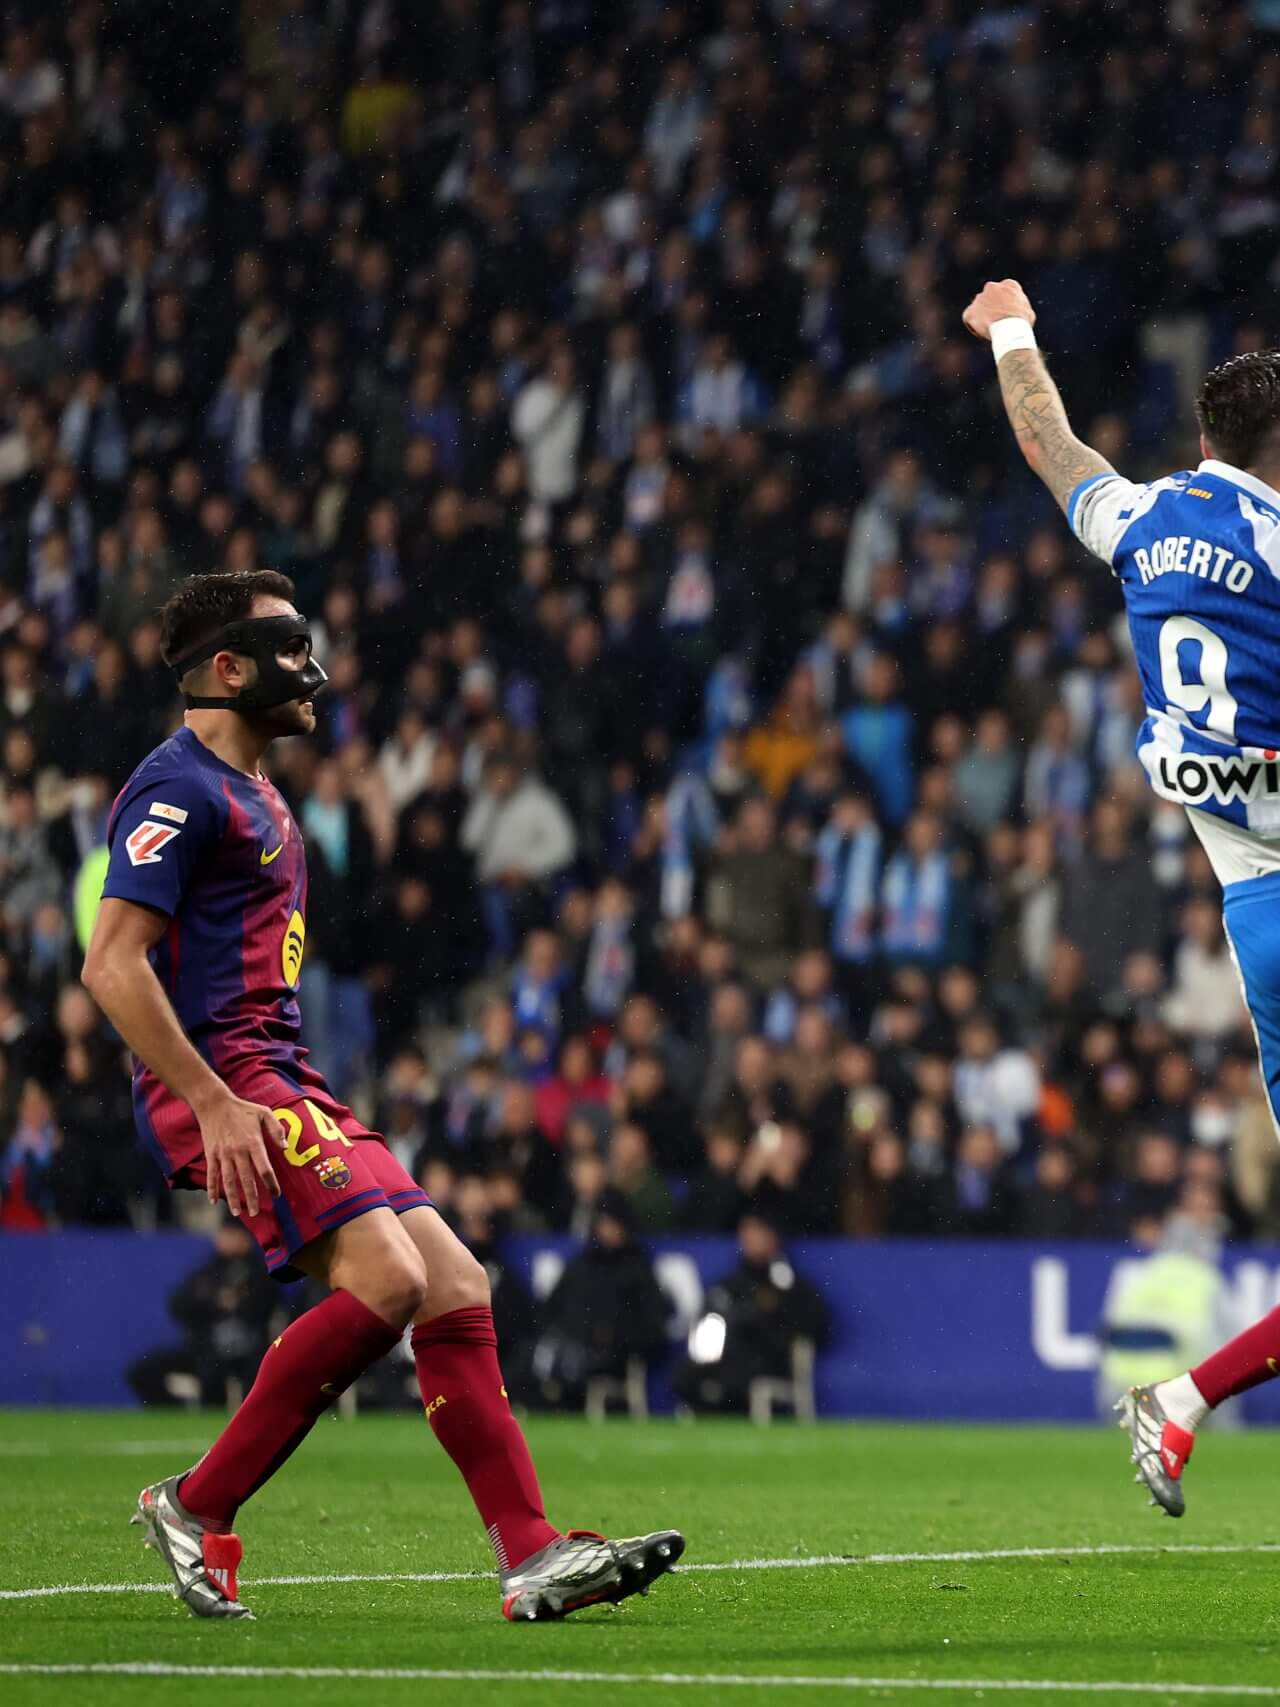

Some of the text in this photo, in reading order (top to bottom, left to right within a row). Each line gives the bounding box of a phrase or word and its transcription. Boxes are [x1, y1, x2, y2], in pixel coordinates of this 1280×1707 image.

[1133, 535, 1255, 594] ROBERTO
[1159, 615, 1239, 747] 9
[272, 1099, 354, 1167] 24
